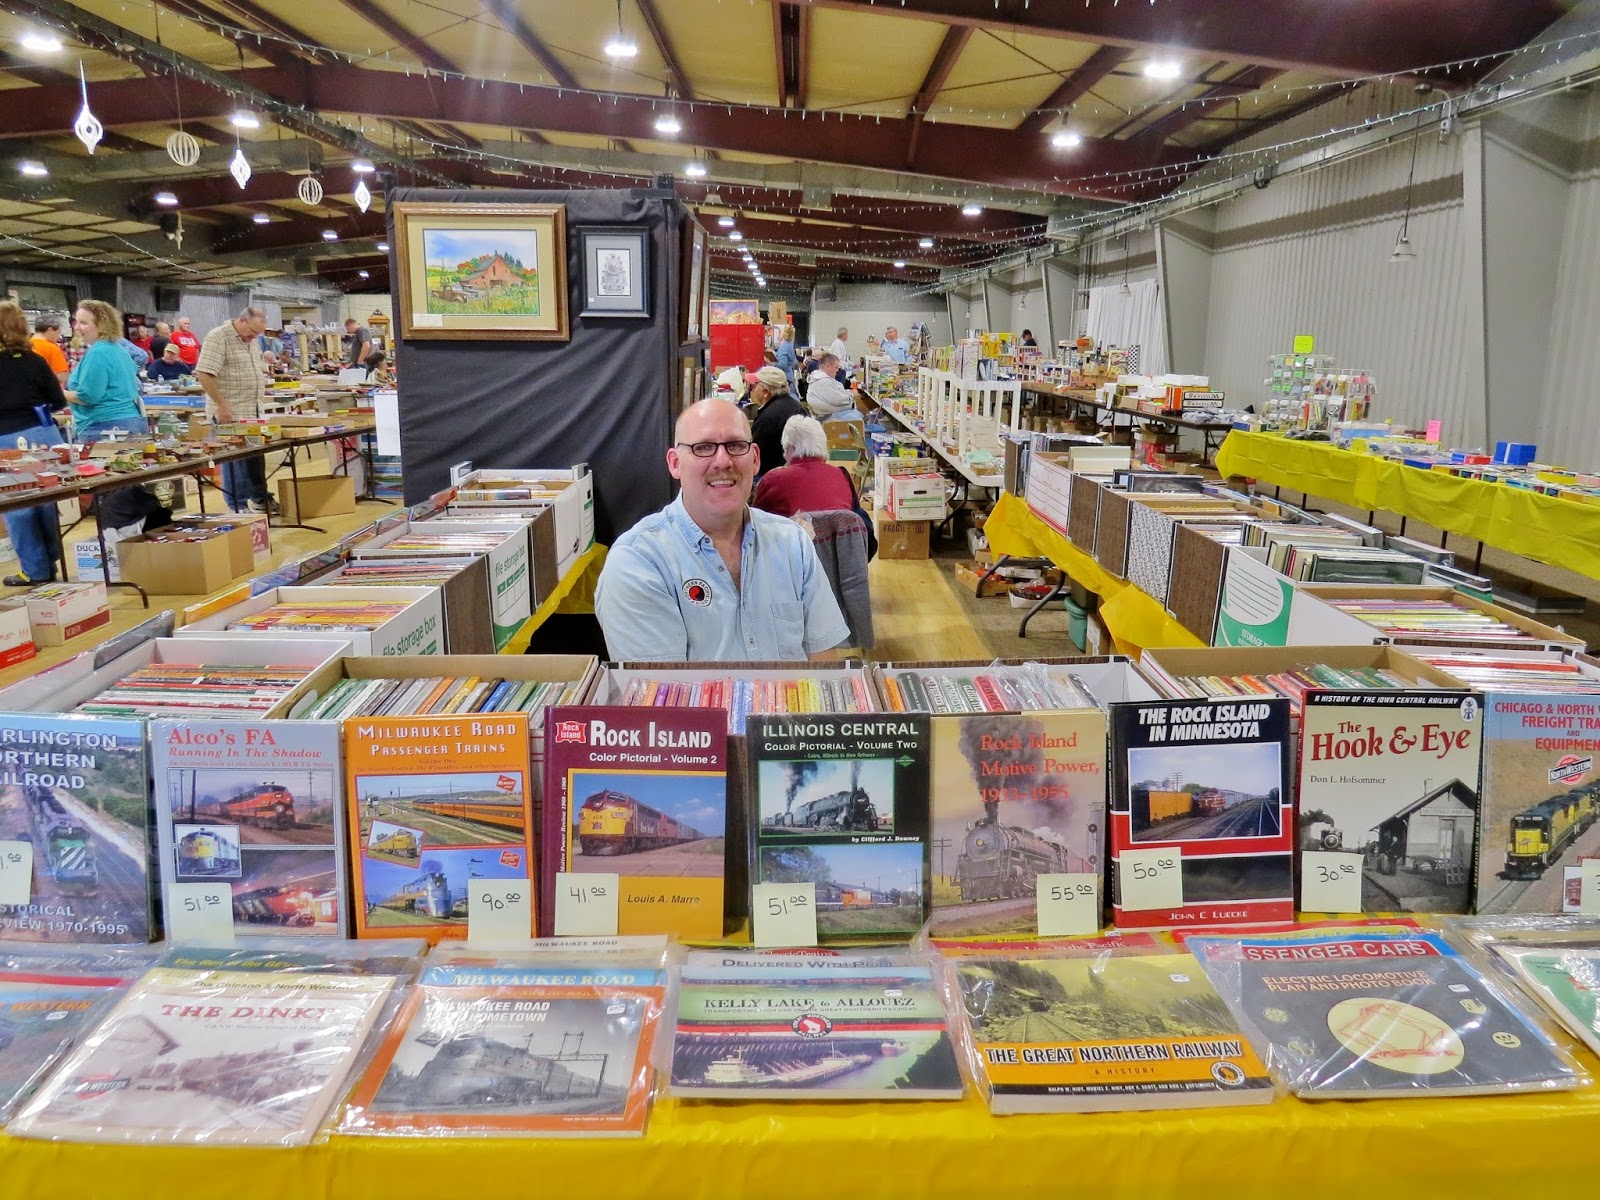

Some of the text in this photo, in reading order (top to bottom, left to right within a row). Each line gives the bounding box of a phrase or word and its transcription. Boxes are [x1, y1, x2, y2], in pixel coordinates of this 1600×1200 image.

[76, 544, 100, 552] DUCK
[494, 561, 504, 578] file
[504, 550, 519, 570] storage
[396, 623, 425, 655] storage
[424, 613, 437, 635] box
[1241, 628, 1263, 647] STORAGE
[1314, 694, 1320, 702] A
[1320, 695, 1351, 703] HISTORY
[1351, 695, 1361, 703] OF
[1376, 696, 1395, 704] IOWA
[1427, 697, 1459, 705] RAILWAY
[1138, 703, 1271, 725] THE ROCK ISLAND
[1494, 702, 1595, 715] CHICAGO & NORTH
[562, 723, 580, 731] Rock
[1337, 721, 1362, 734] The
[1522, 716, 1575, 728] FREIGHT
[560, 730, 581, 739] Island
[763, 722, 919, 737] ILLINOIS CENTRAL
[1148, 721, 1260, 742] IN MINNESOTA
[1, 728, 118, 749] RLINGTON
[168, 727, 277, 746] Alco's FA
[980, 731, 1077, 751] Rock Island
[1310, 726, 1384, 761] Hook
[1388, 725, 1418, 755] &
[1420, 724, 1472, 760] Eye
[0, 749, 97, 769] RTHERN
[168, 747, 322, 759] Running In The Shadow
[589, 752, 717, 764] Color Pictorial Volume 2
[981, 758, 1100, 776] Motive Power,
[0, 771, 86, 790] ILROAD
[1310, 775, 1386, 784] Don L. Hofsommer
[627, 894, 700, 904] Louis A. Marre
[1168, 910, 1248, 921] JOHN C LUECKE
[47, 920, 126, 936] 1970-1995
[534, 940, 588, 948] MILWAUKEE
[1088, 939, 1126, 949] Pacific
[1240, 940, 1428, 961] SSENGER CARS
[452, 974, 636, 985] MILWAUKEE ROAD
[1261, 970, 1430, 985] ELECTRIC LOCOMOTIVE
[1267, 976, 1436, 993] PLAN AND PHOTO BOOK
[513, 1001, 551, 1011] ROAD
[704, 997, 916, 1008] KELLY LAKE to ALLOUEZ
[161, 1004, 224, 1018] THE
[468, 1012, 547, 1023] HOMETOWN
[986, 1039, 1243, 1064] THE GREAT NORTHERN RAILWAY
[1107, 1067, 1156, 1075] HISTORY
